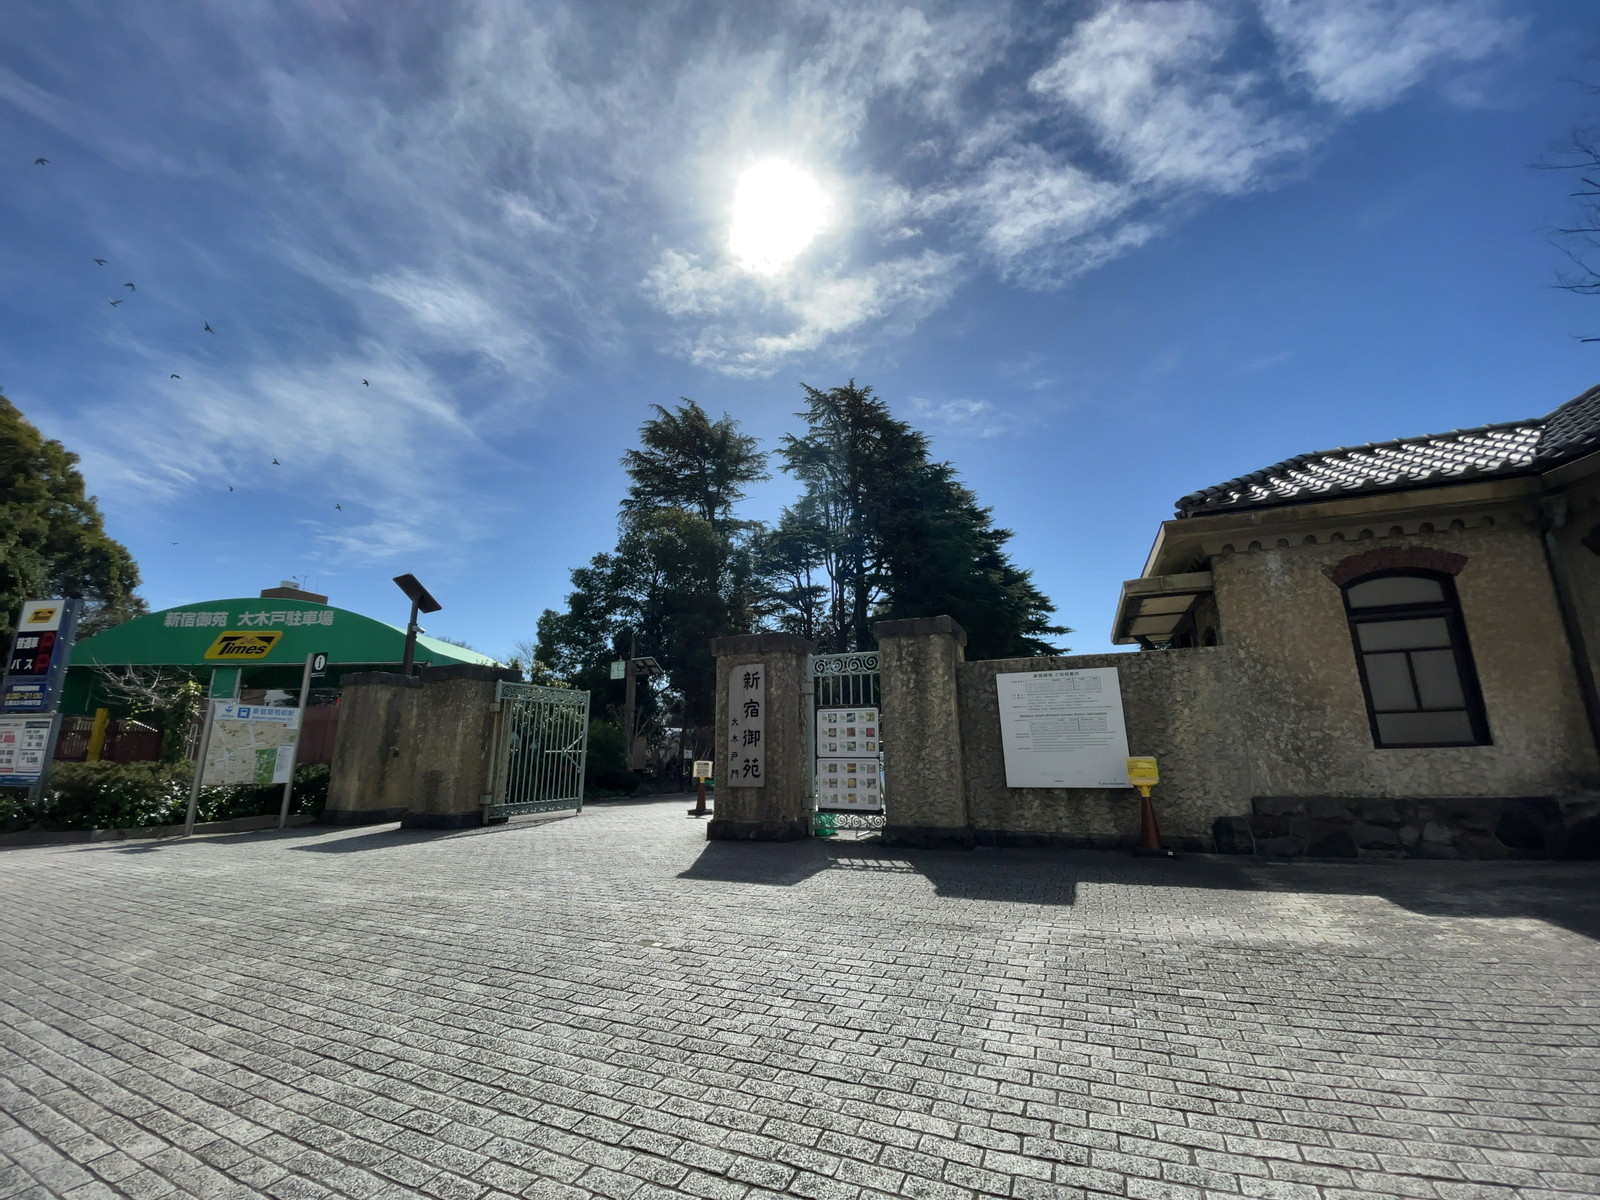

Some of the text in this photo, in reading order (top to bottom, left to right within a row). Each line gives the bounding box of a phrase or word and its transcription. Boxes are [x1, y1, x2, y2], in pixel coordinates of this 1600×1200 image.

[164, 611, 334, 627] 新宿御苑 大木戸駐車場
[217, 638, 269, 656] Times
[11, 659, 33, 670] バス
[743, 671, 761, 779] 新宿御苑
[730, 718, 739, 779] 大木戸門
